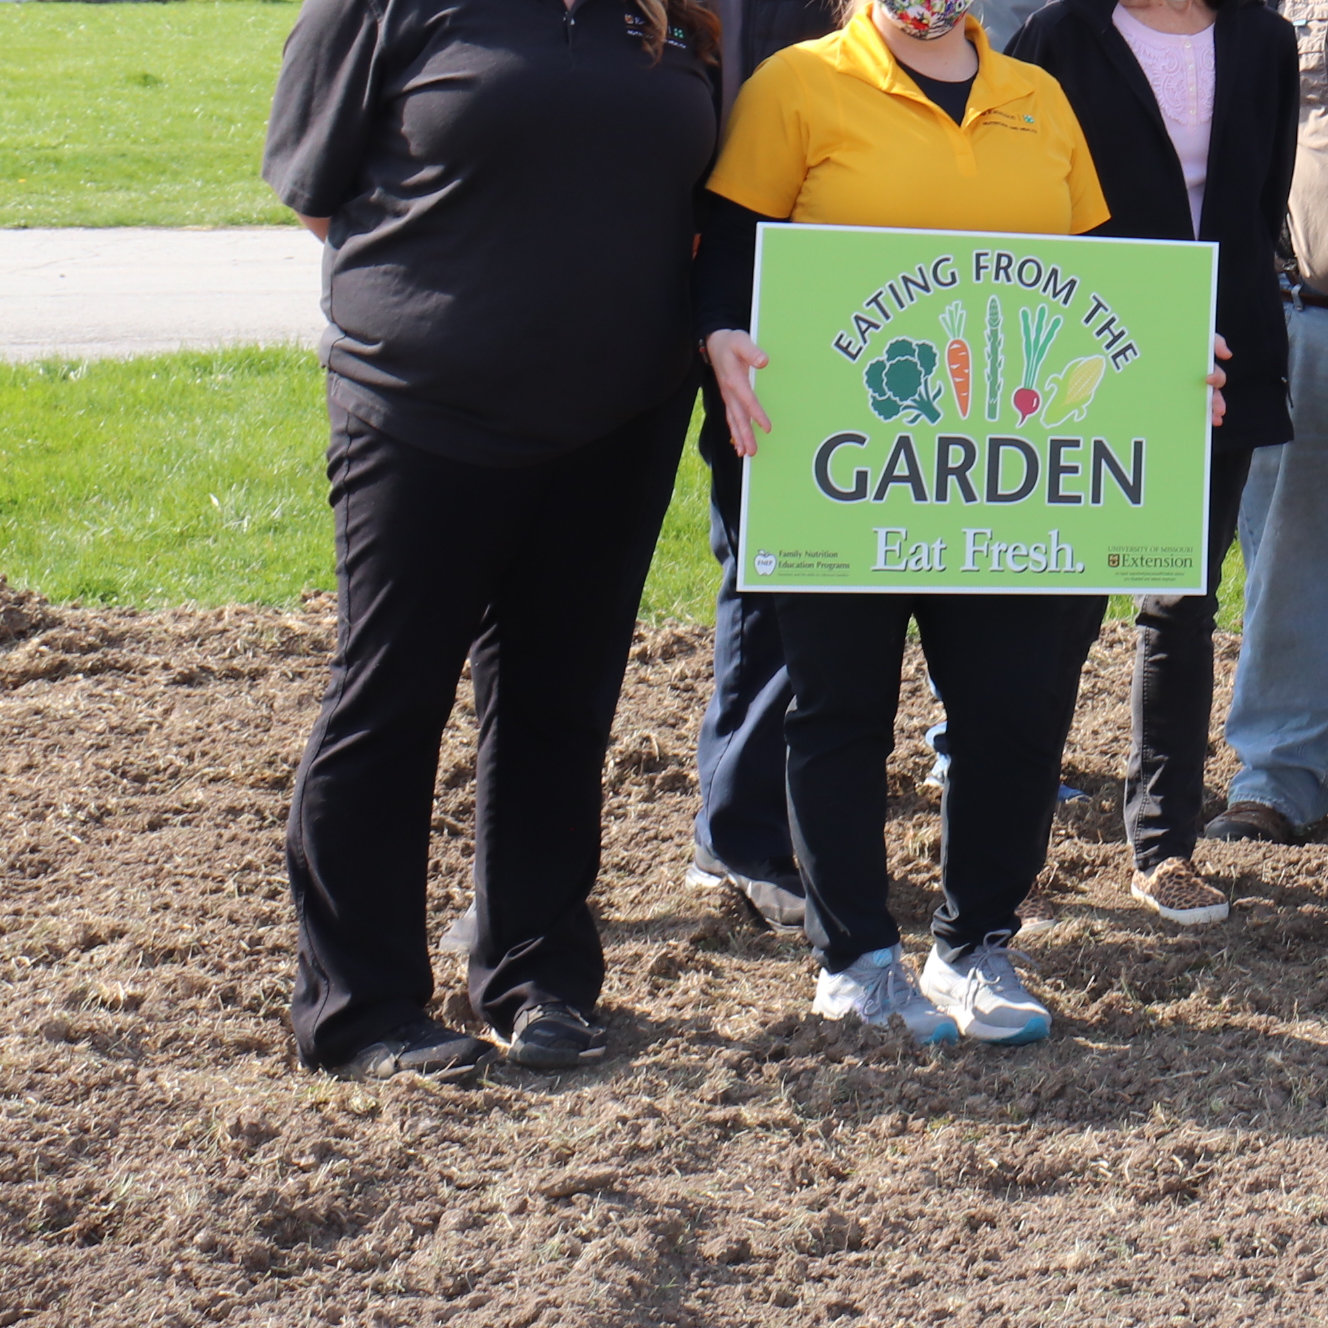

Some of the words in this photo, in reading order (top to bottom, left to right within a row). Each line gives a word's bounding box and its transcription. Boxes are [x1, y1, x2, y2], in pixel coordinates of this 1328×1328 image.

[831, 255, 958, 362] EATING
[973, 250, 1079, 307] FROM
[1081, 293, 1140, 372] THE
[813, 431, 1146, 506] GARDEN
[778, 550, 802, 560] Family
[805, 549, 838, 558] Nutrition
[778, 560, 815, 569] Education
[816, 561, 850, 570] Programs
[870, 527, 948, 572] Eat
[959, 528, 1086, 574] Fresh.
[1121, 554, 1193, 568] Extension
